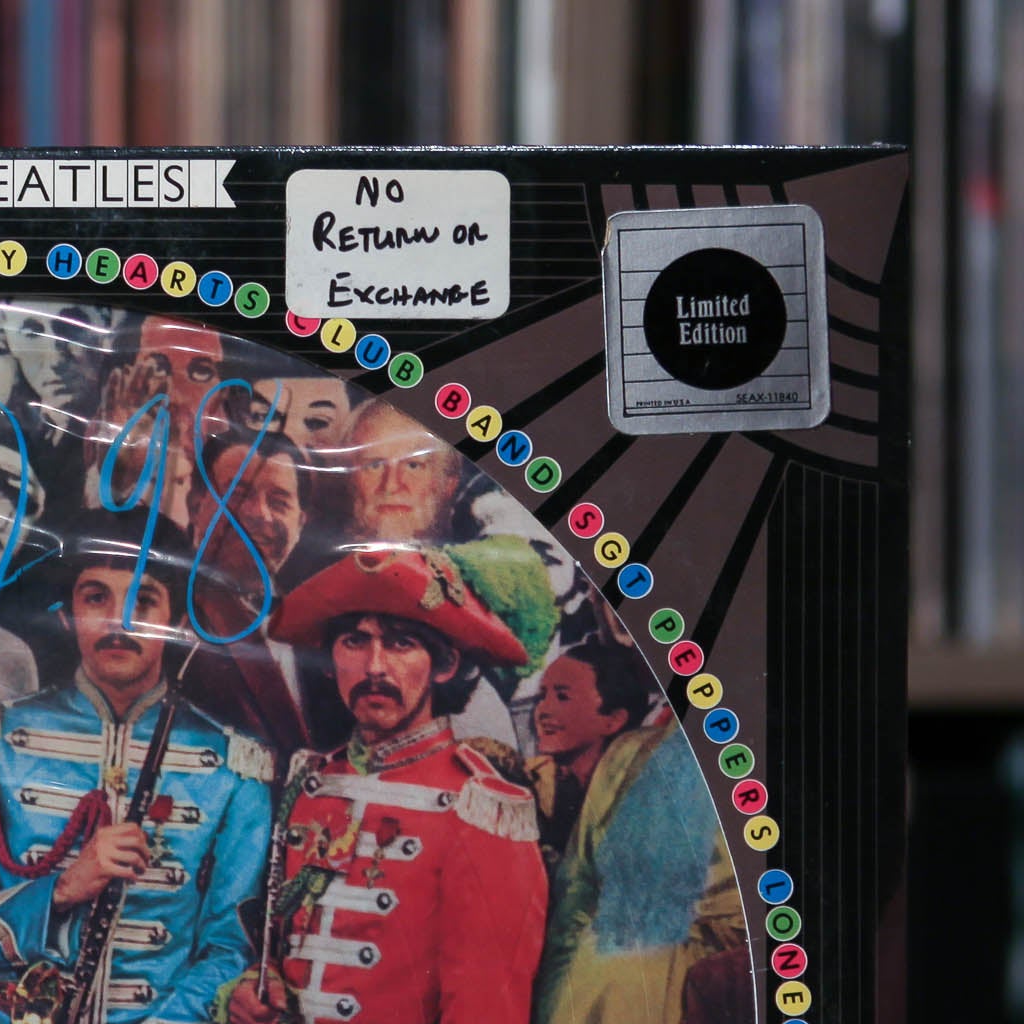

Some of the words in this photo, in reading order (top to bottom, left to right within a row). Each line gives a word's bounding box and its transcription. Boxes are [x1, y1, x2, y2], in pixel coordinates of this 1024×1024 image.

[355, 176, 404, 207] NO
[676, 293, 751, 319] Limited
[679, 322, 748, 345] Edition
[53, 250, 261, 312] HEARTS
[441, 389, 555, 487] BAND
[635, 400, 662, 408] PRINTED
[574, 510, 647, 589] SGT
[653, 615, 773, 842] PEPPERS
